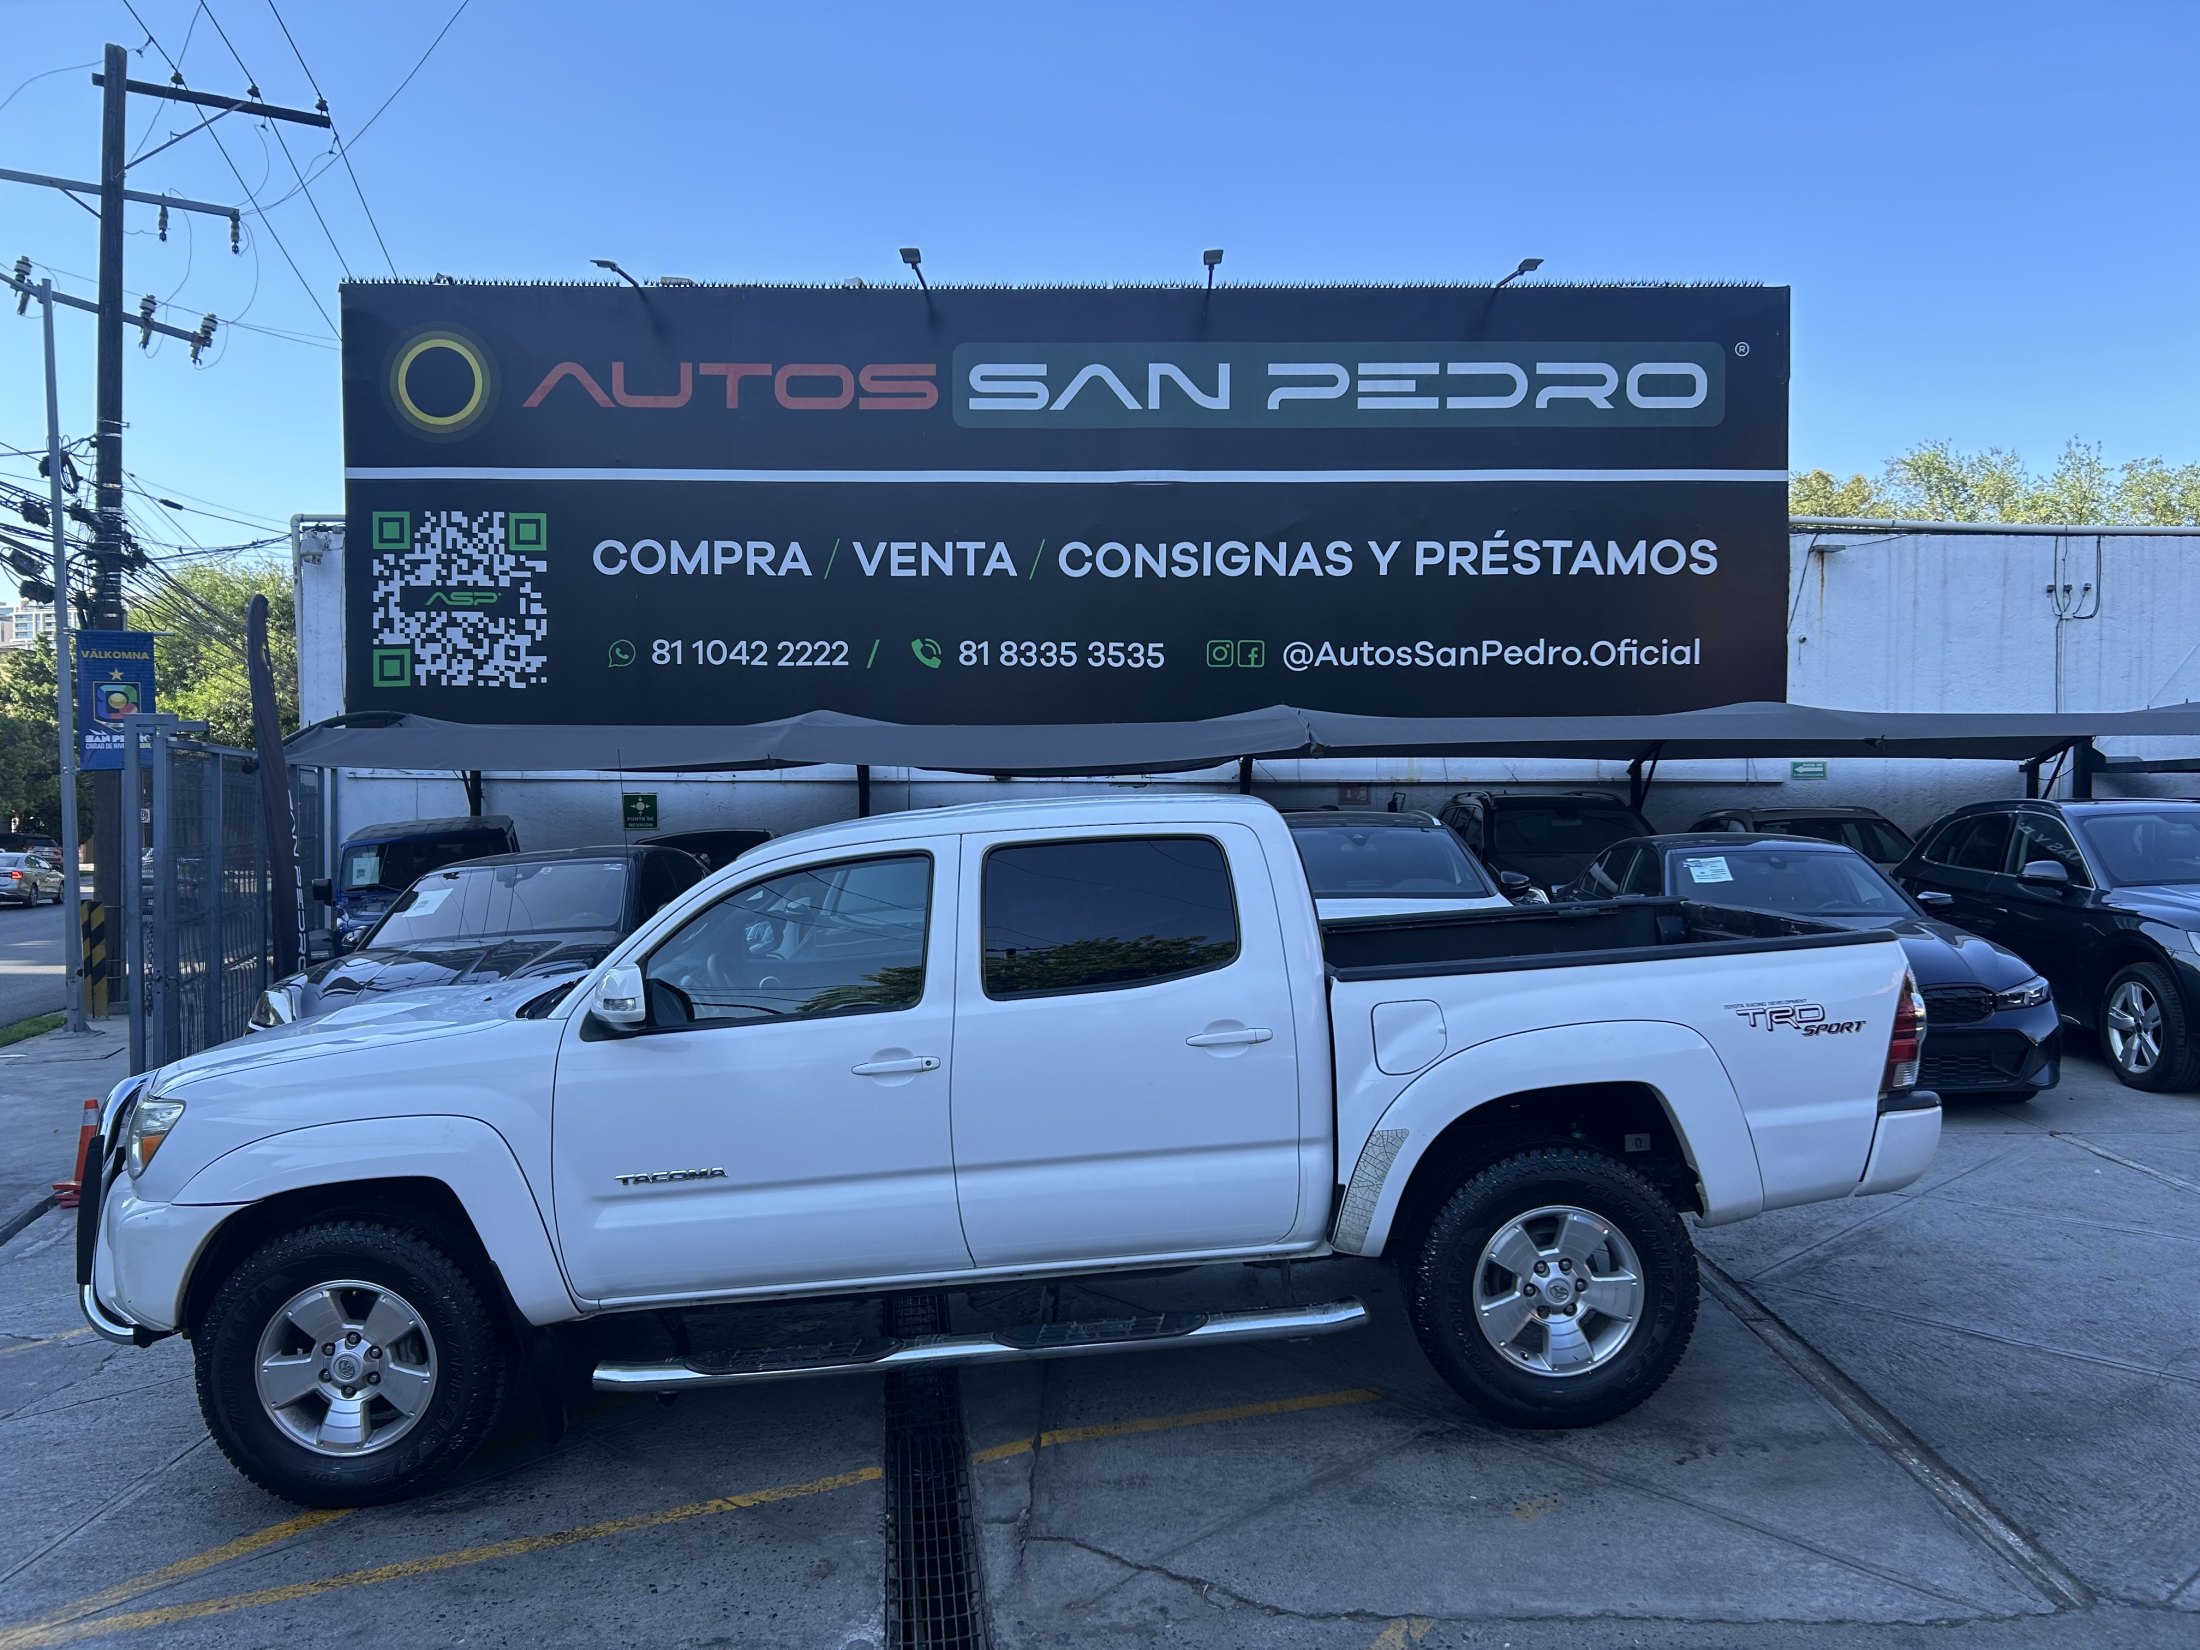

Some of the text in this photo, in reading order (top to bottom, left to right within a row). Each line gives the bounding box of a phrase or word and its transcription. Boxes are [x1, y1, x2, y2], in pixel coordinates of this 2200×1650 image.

[523, 361, 939, 410] AUTOS
[969, 362, 1231, 411] SAN
[1267, 362, 1708, 410] PEDRO
[592, 538, 813, 577] COMPRA
[852, 541, 1018, 577] VENTA
[1058, 540, 1353, 578] CONSIGNAS
[1367, 540, 1401, 576] Y
[1415, 530, 1718, 577] PRÉSTAMOS
[425, 591, 498, 606] ASP
[81, 648, 150, 660] VÄLKOMNA
[651, 639, 681, 665] 81
[692, 639, 768, 666] 1042
[777, 640, 849, 667] 2222
[958, 640, 1165, 669] 81 8335 3535
[1283, 638, 1701, 672] @AutosSanPedro.Oficial
[294, 865, 307, 973] PEDRO
[1735, 1003, 1826, 1032] TRD
[1801, 1020, 1867, 1037] SPORT
[614, 1167, 729, 1186] TACOMA
